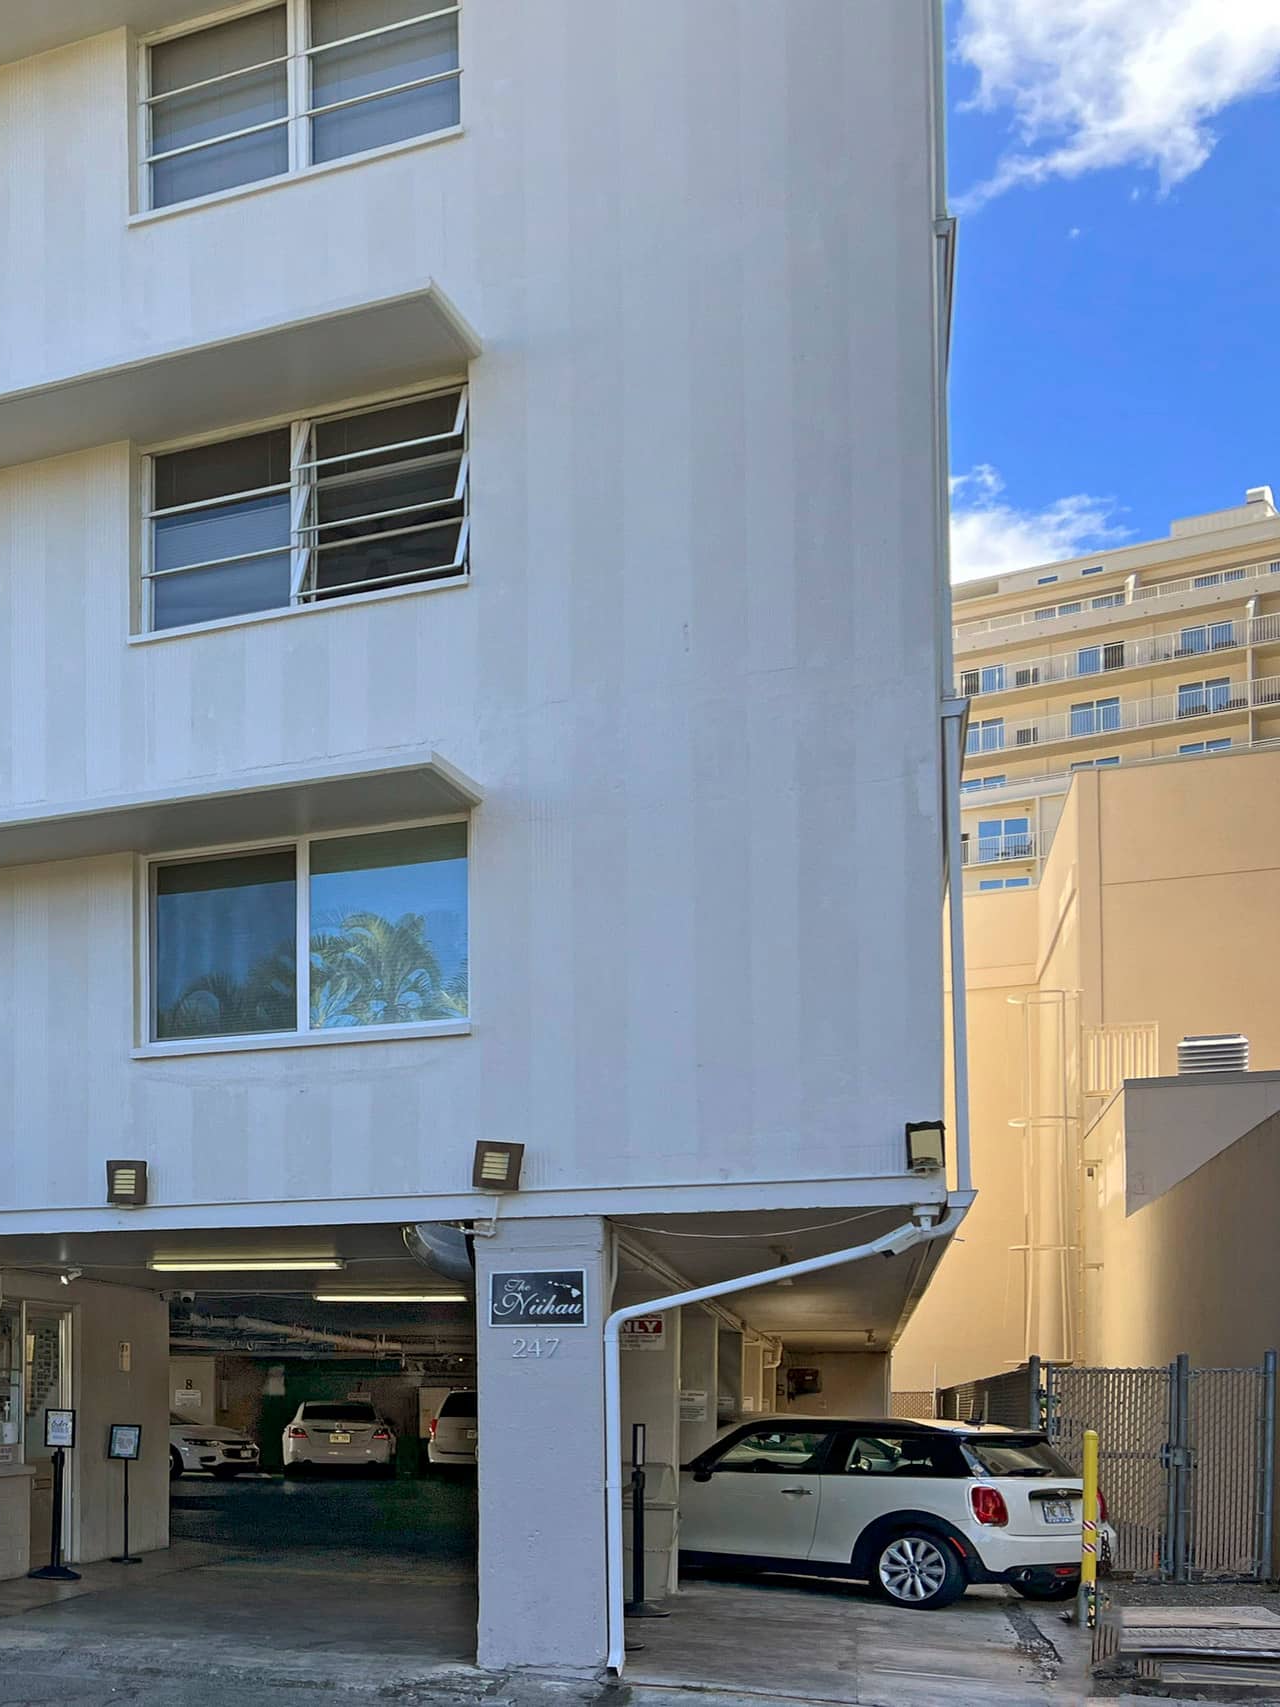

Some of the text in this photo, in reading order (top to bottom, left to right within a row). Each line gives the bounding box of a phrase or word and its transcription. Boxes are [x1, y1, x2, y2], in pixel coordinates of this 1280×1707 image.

[503, 1278, 532, 1292] The
[493, 1292, 583, 1316] Niihau
[623, 1321, 658, 1333] NLY
[511, 1337, 561, 1359] 247
[185, 1378, 193, 1390] 8
